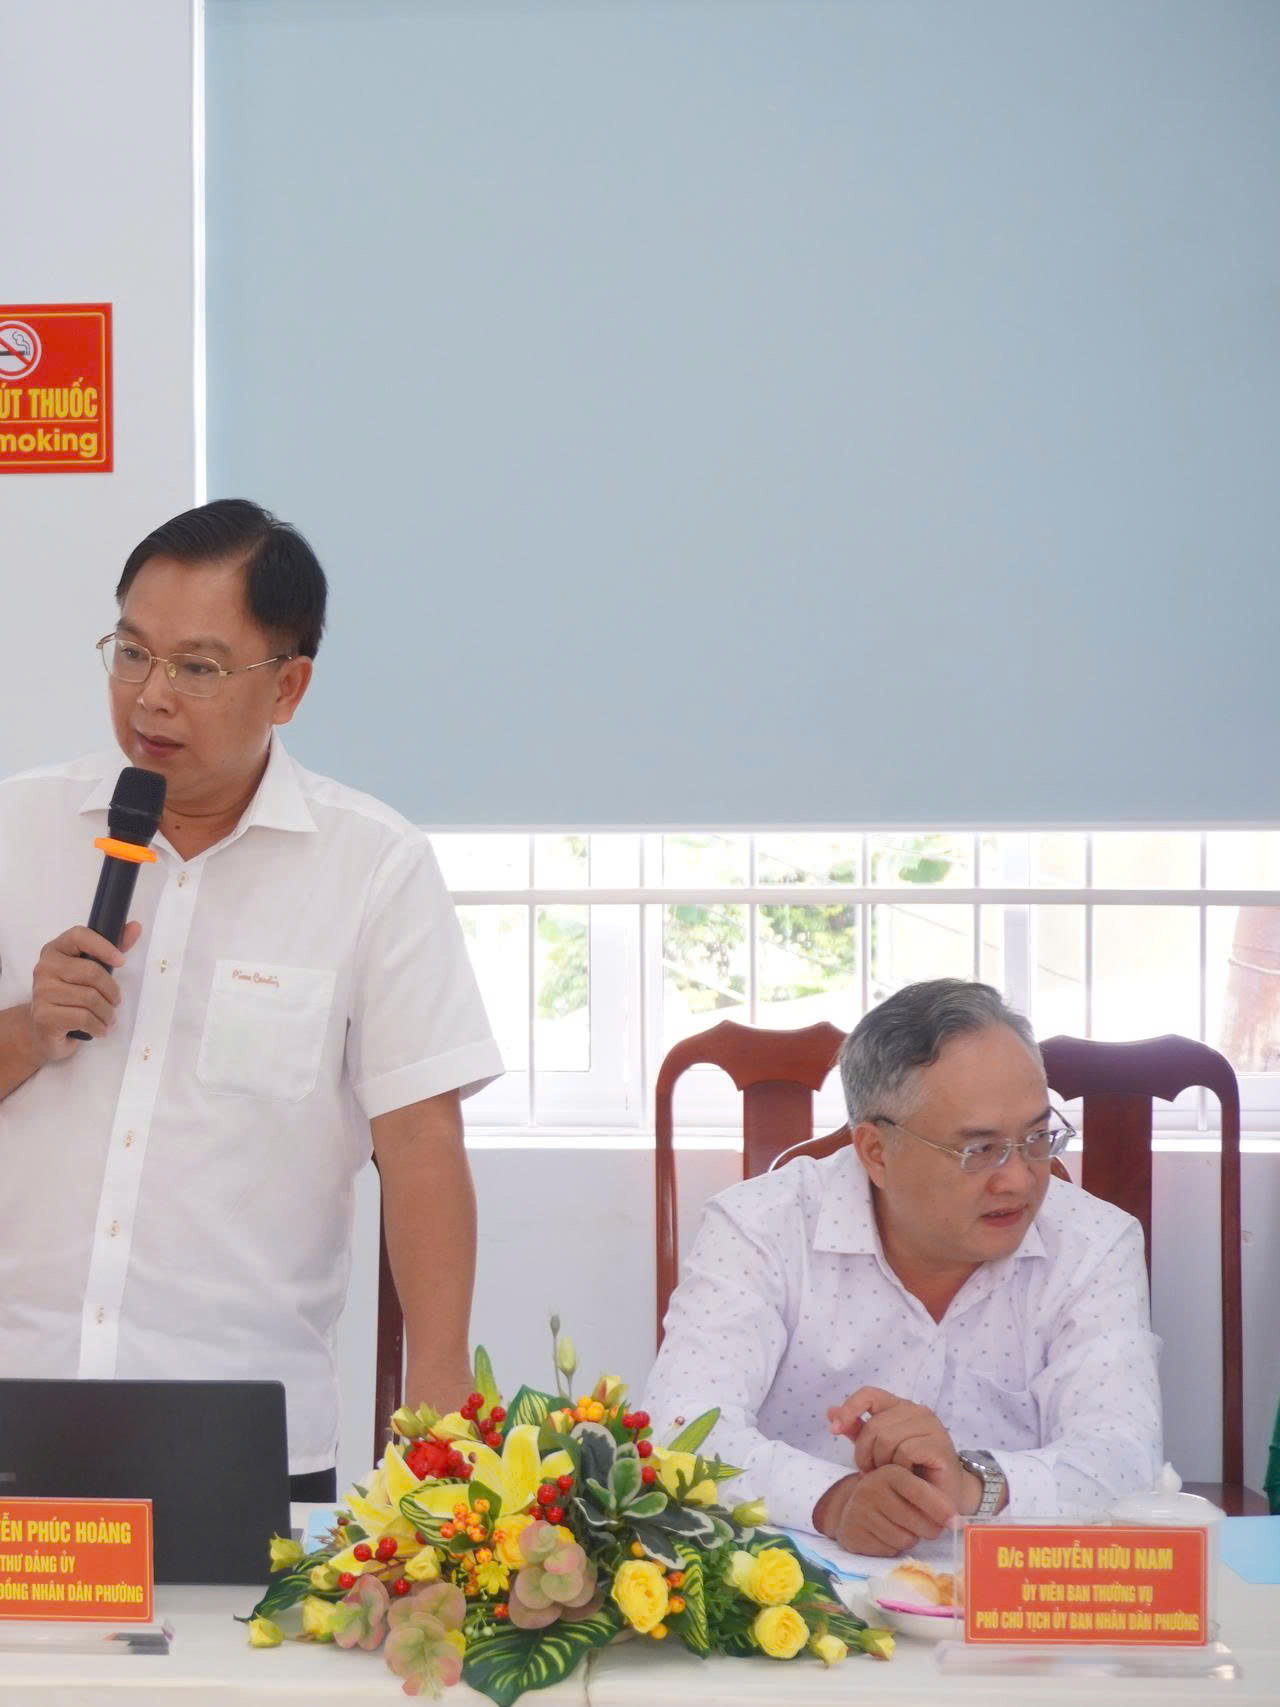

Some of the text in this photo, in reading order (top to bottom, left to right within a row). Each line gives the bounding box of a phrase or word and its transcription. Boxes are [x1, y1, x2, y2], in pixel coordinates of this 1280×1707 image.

[28, 377, 97, 418] THUỐC
[27, 1516, 71, 1544] PHÚC
[75, 1517, 131, 1544] HOÀNG
[0, 1553, 23, 1573] THƯ
[25, 1549, 57, 1573] ĐẢNG
[60, 1549, 76, 1574] ỦY
[1028, 1540, 1093, 1568] NGUYỄN
[1134, 1547, 1173, 1570] NAM
[32, 1580, 64, 1601] NHÂN
[67, 1580, 92, 1602] DÂN
[95, 1579, 143, 1603] PHƯỜNG
[1067, 1584, 1090, 1602] BAN
[1070, 1612, 1093, 1630] BAN
